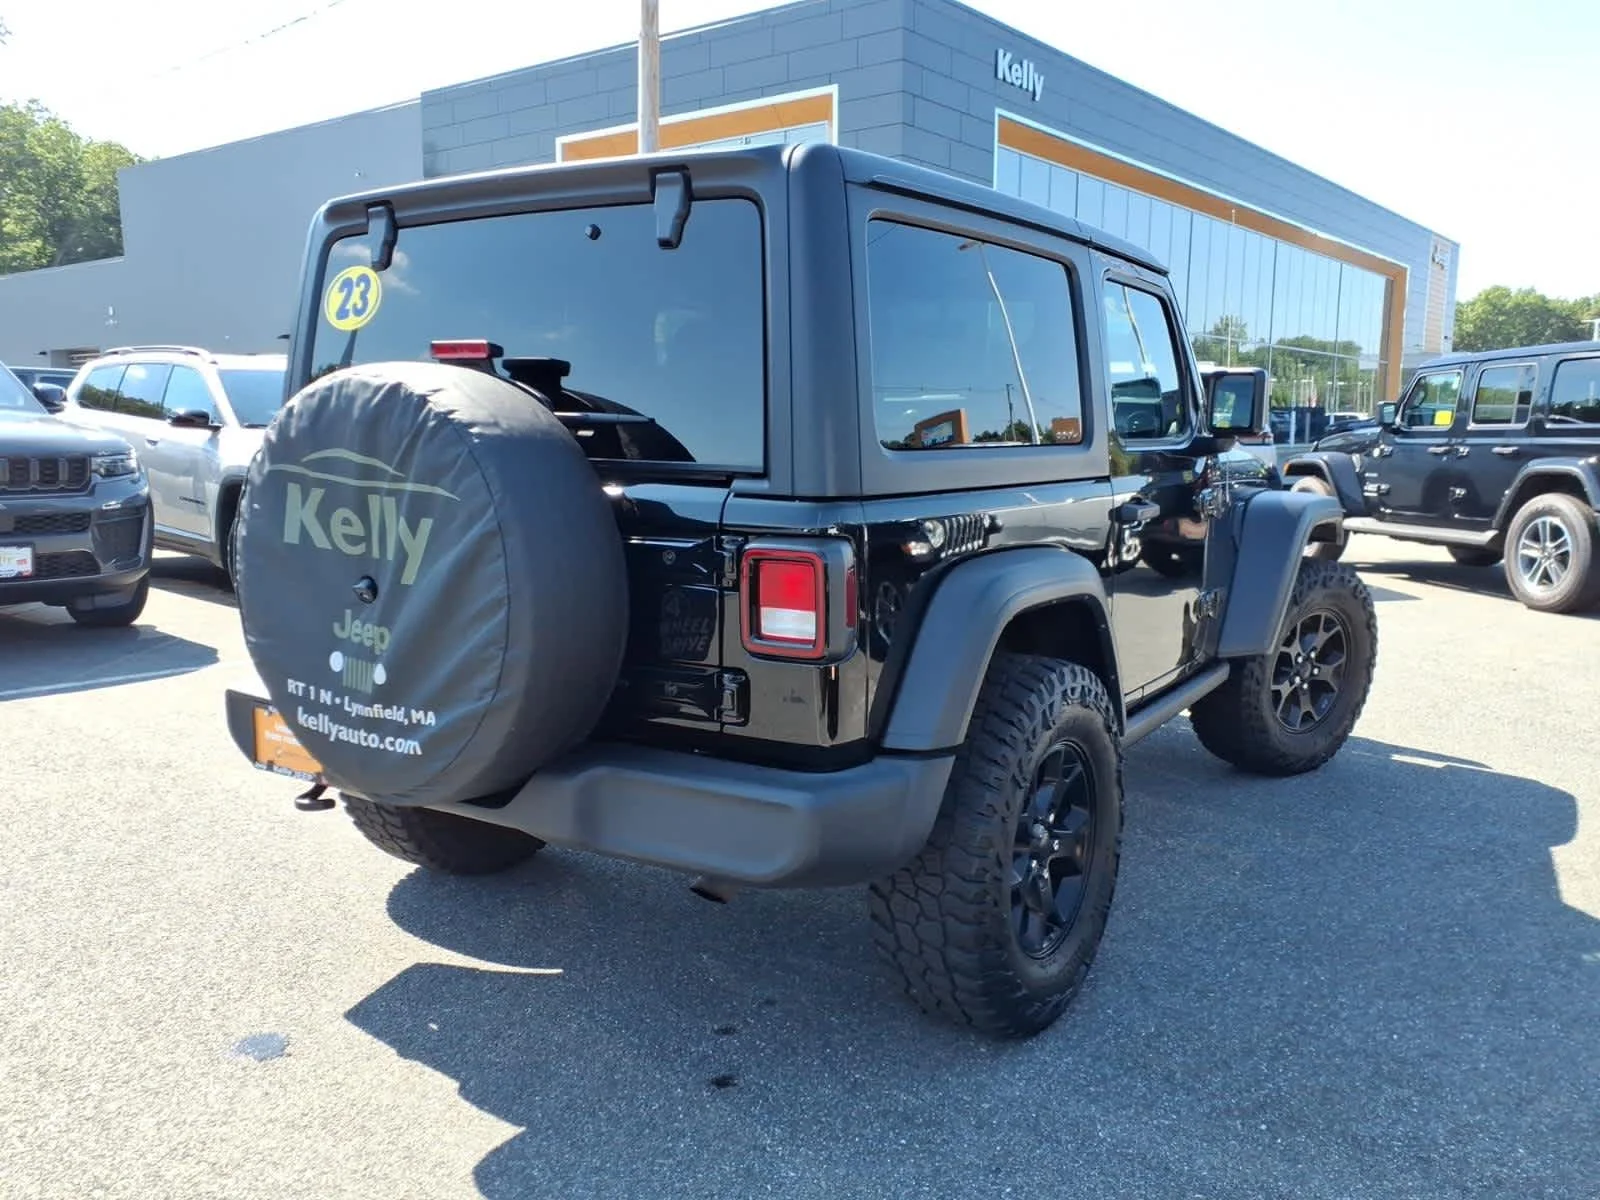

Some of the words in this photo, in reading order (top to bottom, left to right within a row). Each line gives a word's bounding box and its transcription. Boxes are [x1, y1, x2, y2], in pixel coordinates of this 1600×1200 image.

[996, 48, 1044, 102] Kelly
[336, 273, 371, 320] 23
[282, 482, 433, 585] Kelly
[333, 609, 391, 655] Jeep
[287, 678, 306, 697] RT
[309, 685, 315, 700] 1
[319, 688, 332, 705] N
[344, 695, 409, 726] Lynnfield,
[410, 708, 436, 726] MA
[297, 706, 422, 755] kellyauto.com
